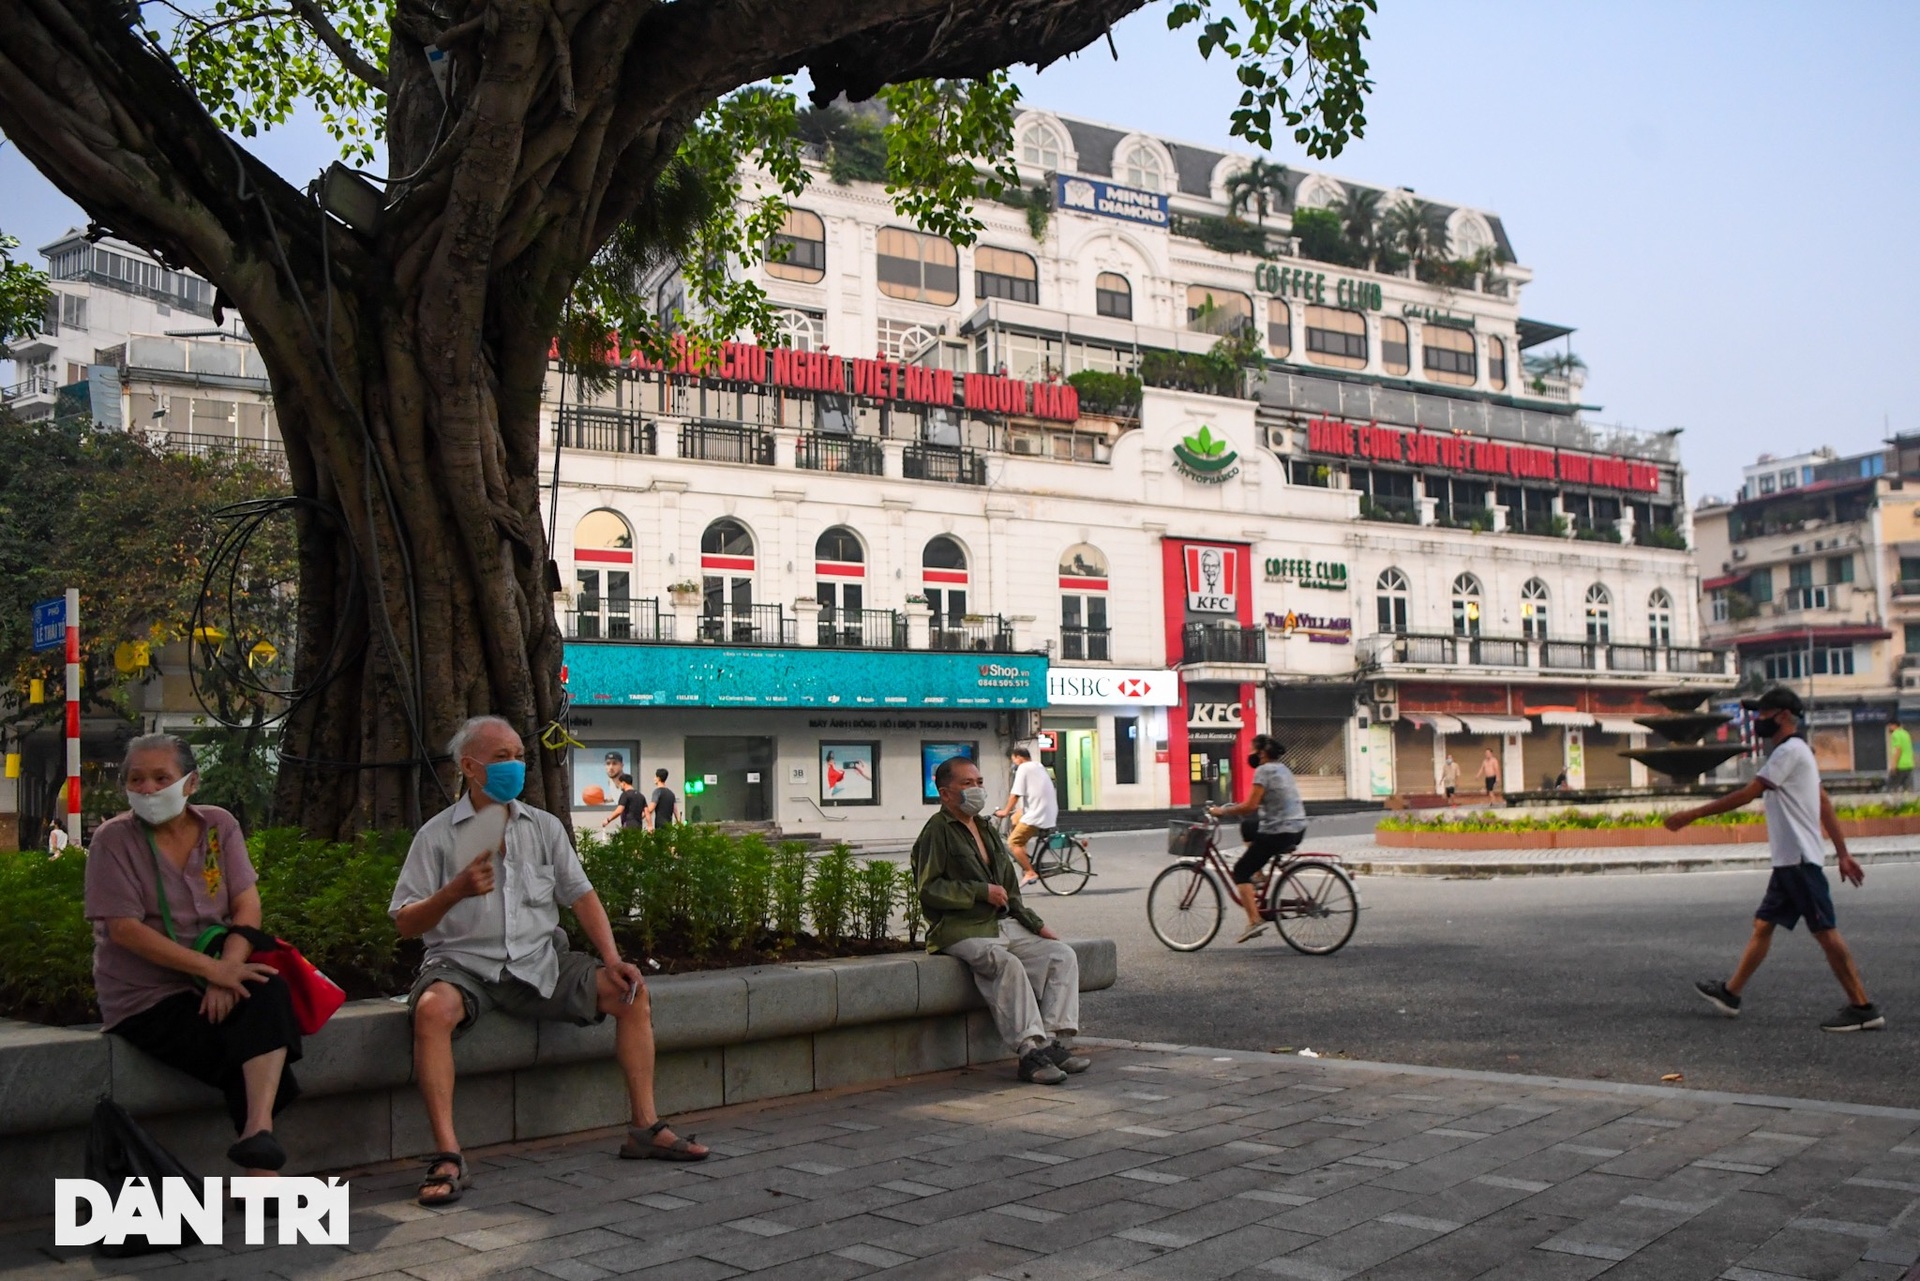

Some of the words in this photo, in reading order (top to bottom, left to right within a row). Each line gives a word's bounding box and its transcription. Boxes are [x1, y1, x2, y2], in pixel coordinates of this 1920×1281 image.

[1106, 186, 1159, 209] MINH
[1098, 199, 1166, 223] DIAMOND
[1255, 262, 1326, 303] COFFEE
[1337, 277, 1382, 311] CLUB
[852, 350, 899, 405] VIỆT
[904, 364, 954, 406] NAM
[964, 366, 1026, 415] MUÔN
[1474, 442, 1508, 475] NAM
[1265, 557, 1312, 578] COFFEE
[1316, 561, 1347, 580] CLUB
[1196, 596, 1229, 610] KFC
[1050, 676, 1111, 698] HSBC
[1191, 702, 1243, 722] KFC
[793, 769, 804, 777] 3B
